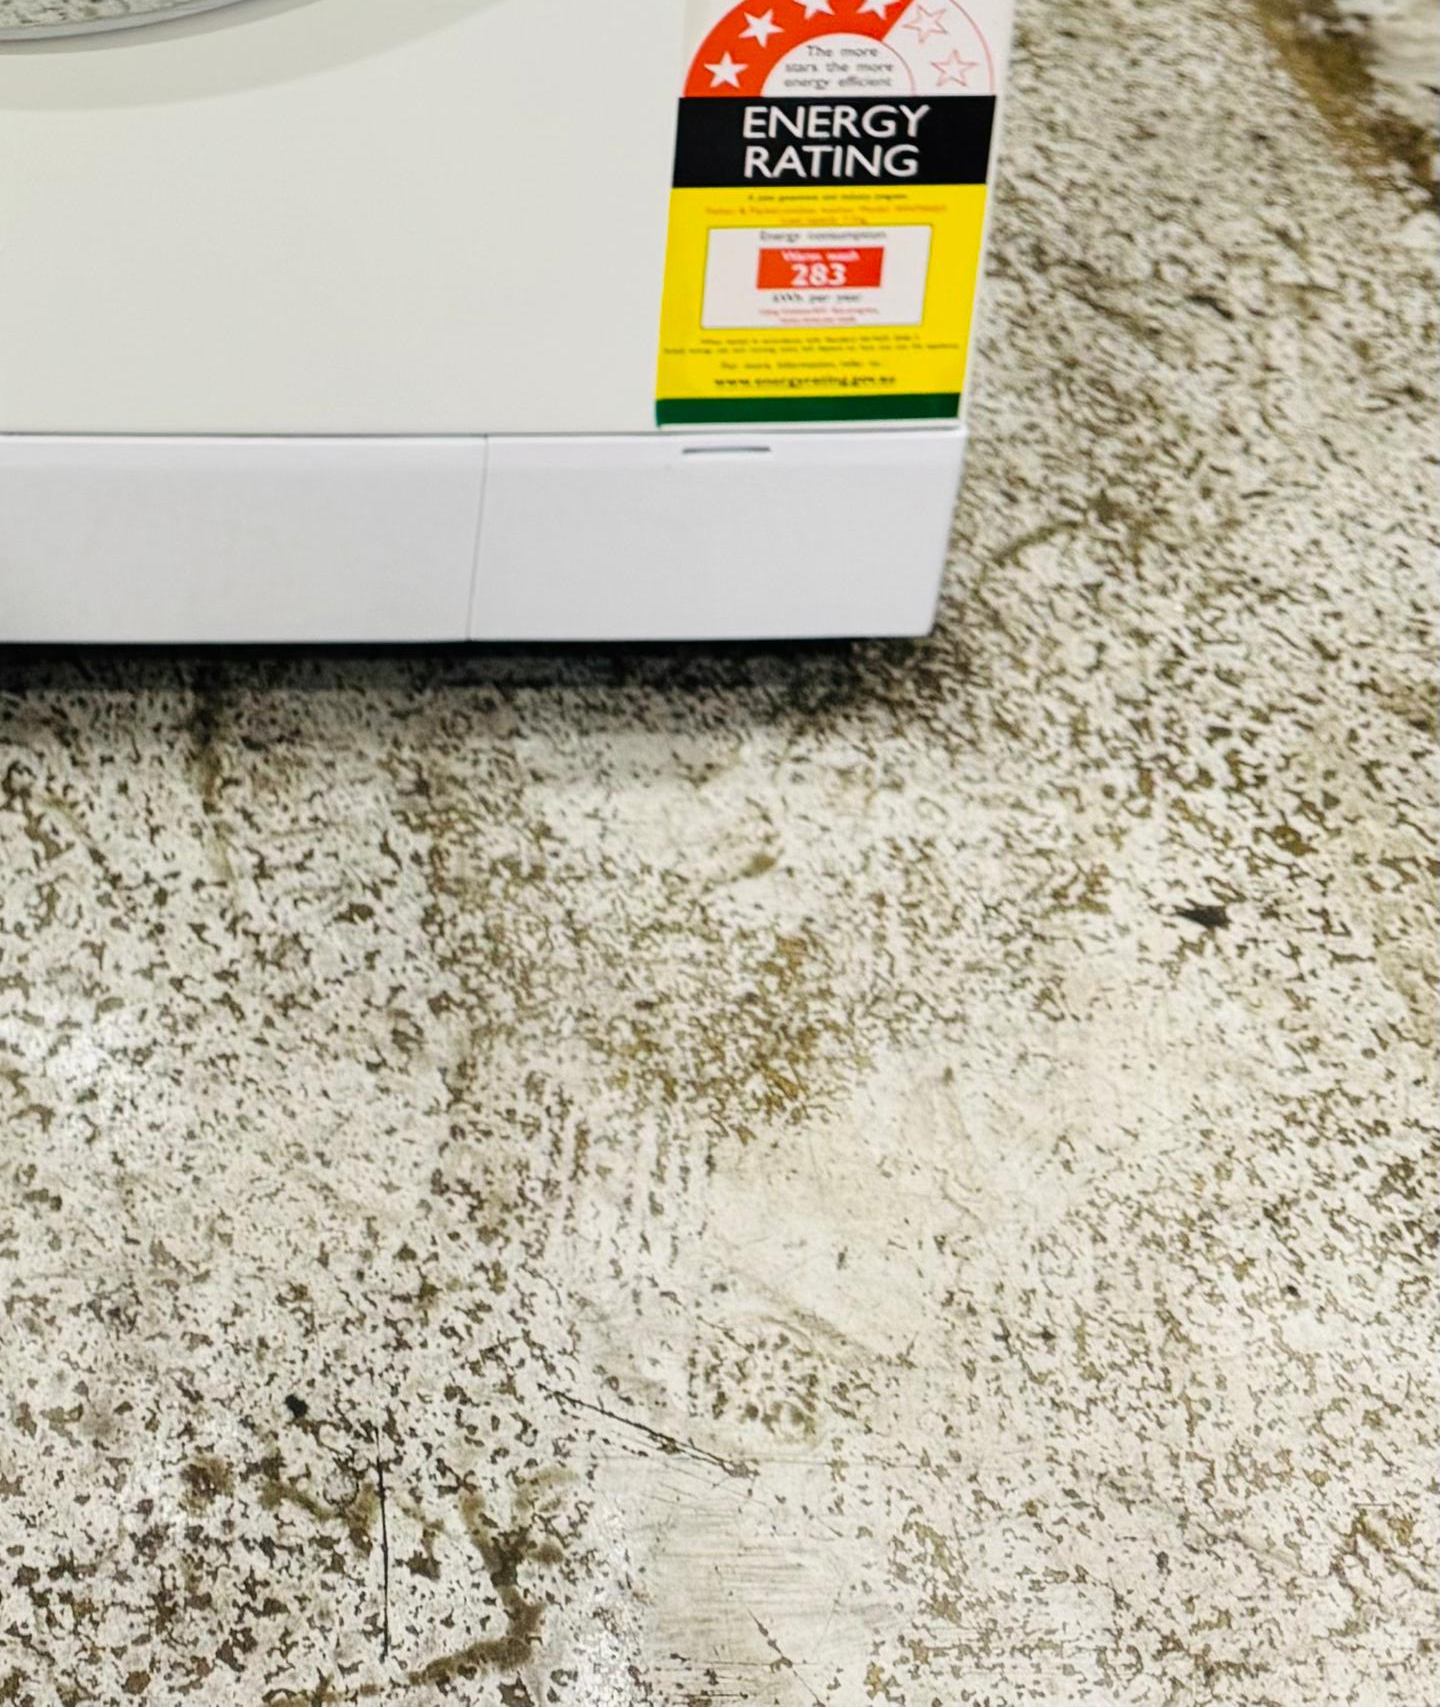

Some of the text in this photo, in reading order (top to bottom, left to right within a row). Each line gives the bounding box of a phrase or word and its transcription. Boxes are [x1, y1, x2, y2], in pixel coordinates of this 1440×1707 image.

[742, 104, 930, 139] ENERGY
[744, 143, 919, 178] RATING
[789, 261, 848, 287] 283
